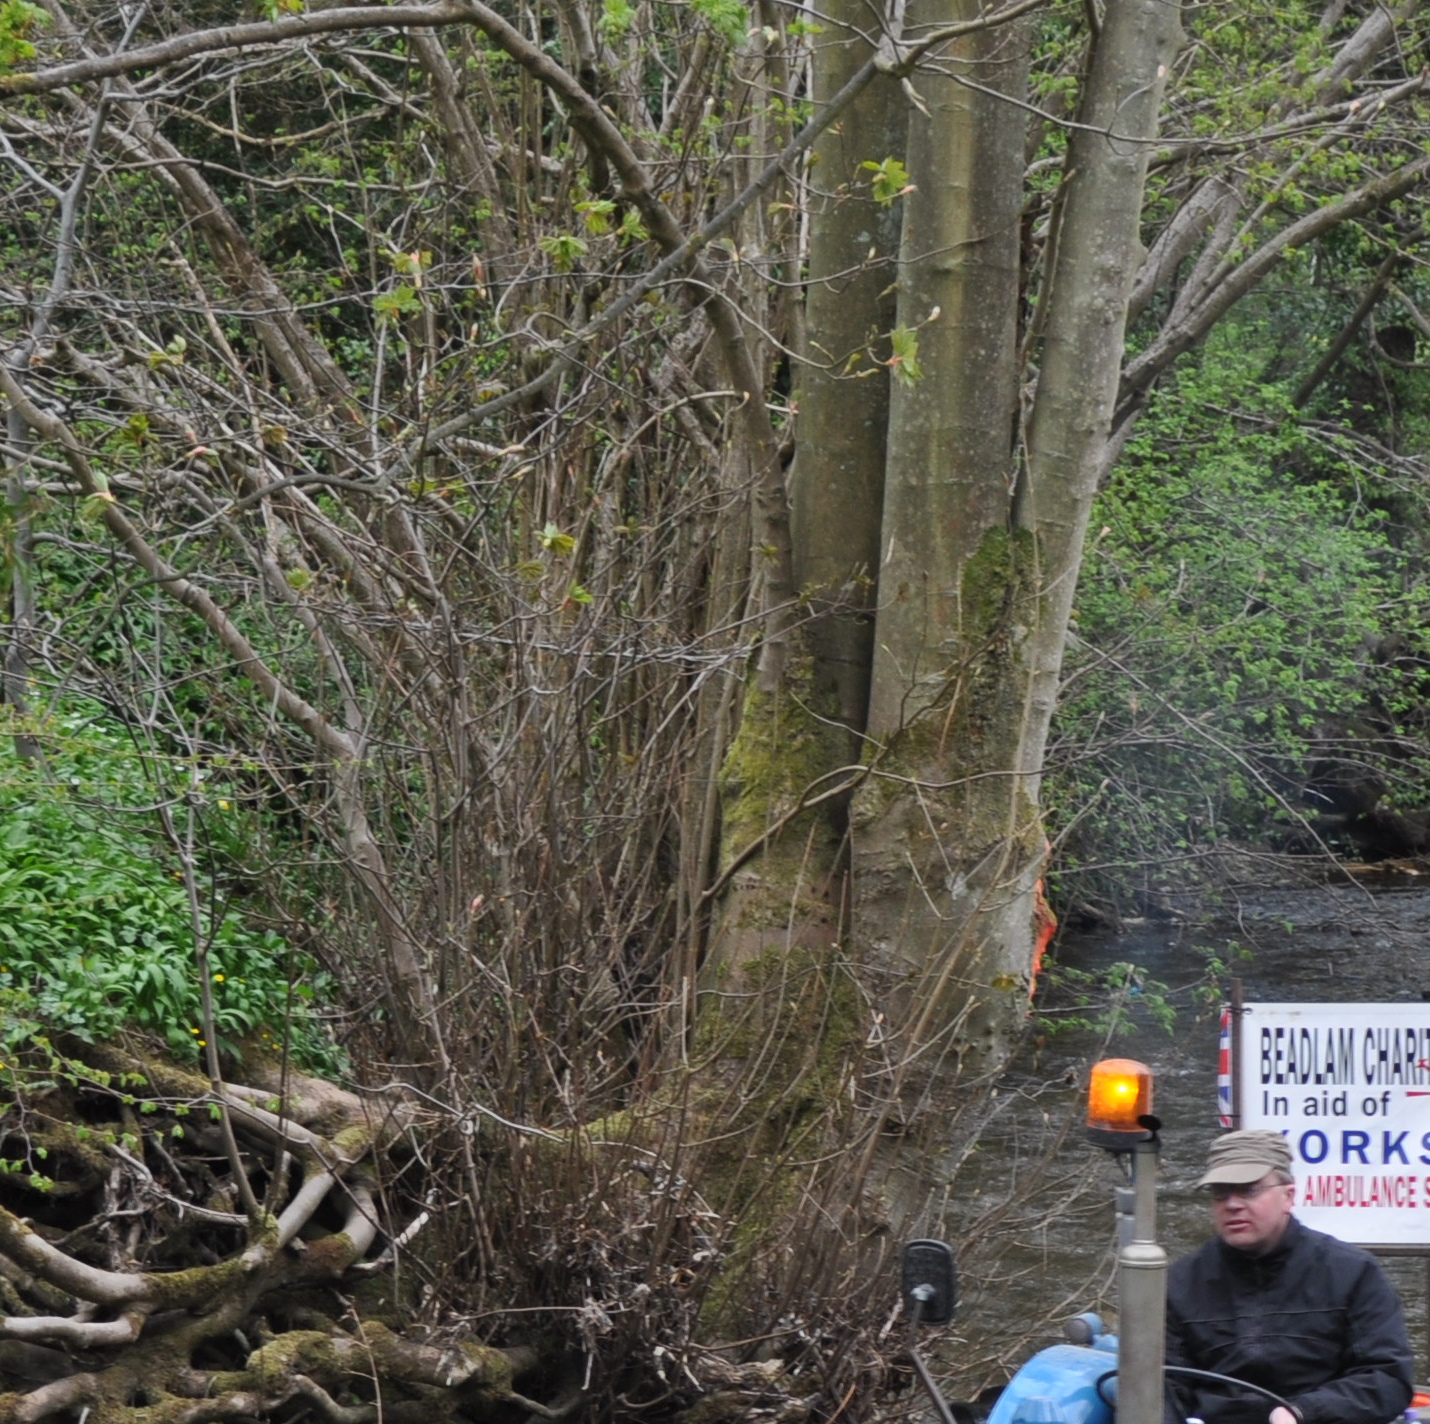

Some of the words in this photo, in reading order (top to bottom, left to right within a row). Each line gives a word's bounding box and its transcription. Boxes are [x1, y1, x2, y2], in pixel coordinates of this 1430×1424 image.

[1261, 1027, 1354, 1085] BEADLAM
[1263, 1090, 1288, 1116] In
[1303, 1090, 1348, 1117] aid
[1362, 1090, 1391, 1117] of
[1303, 1175, 1417, 1208] AMBULANCE
